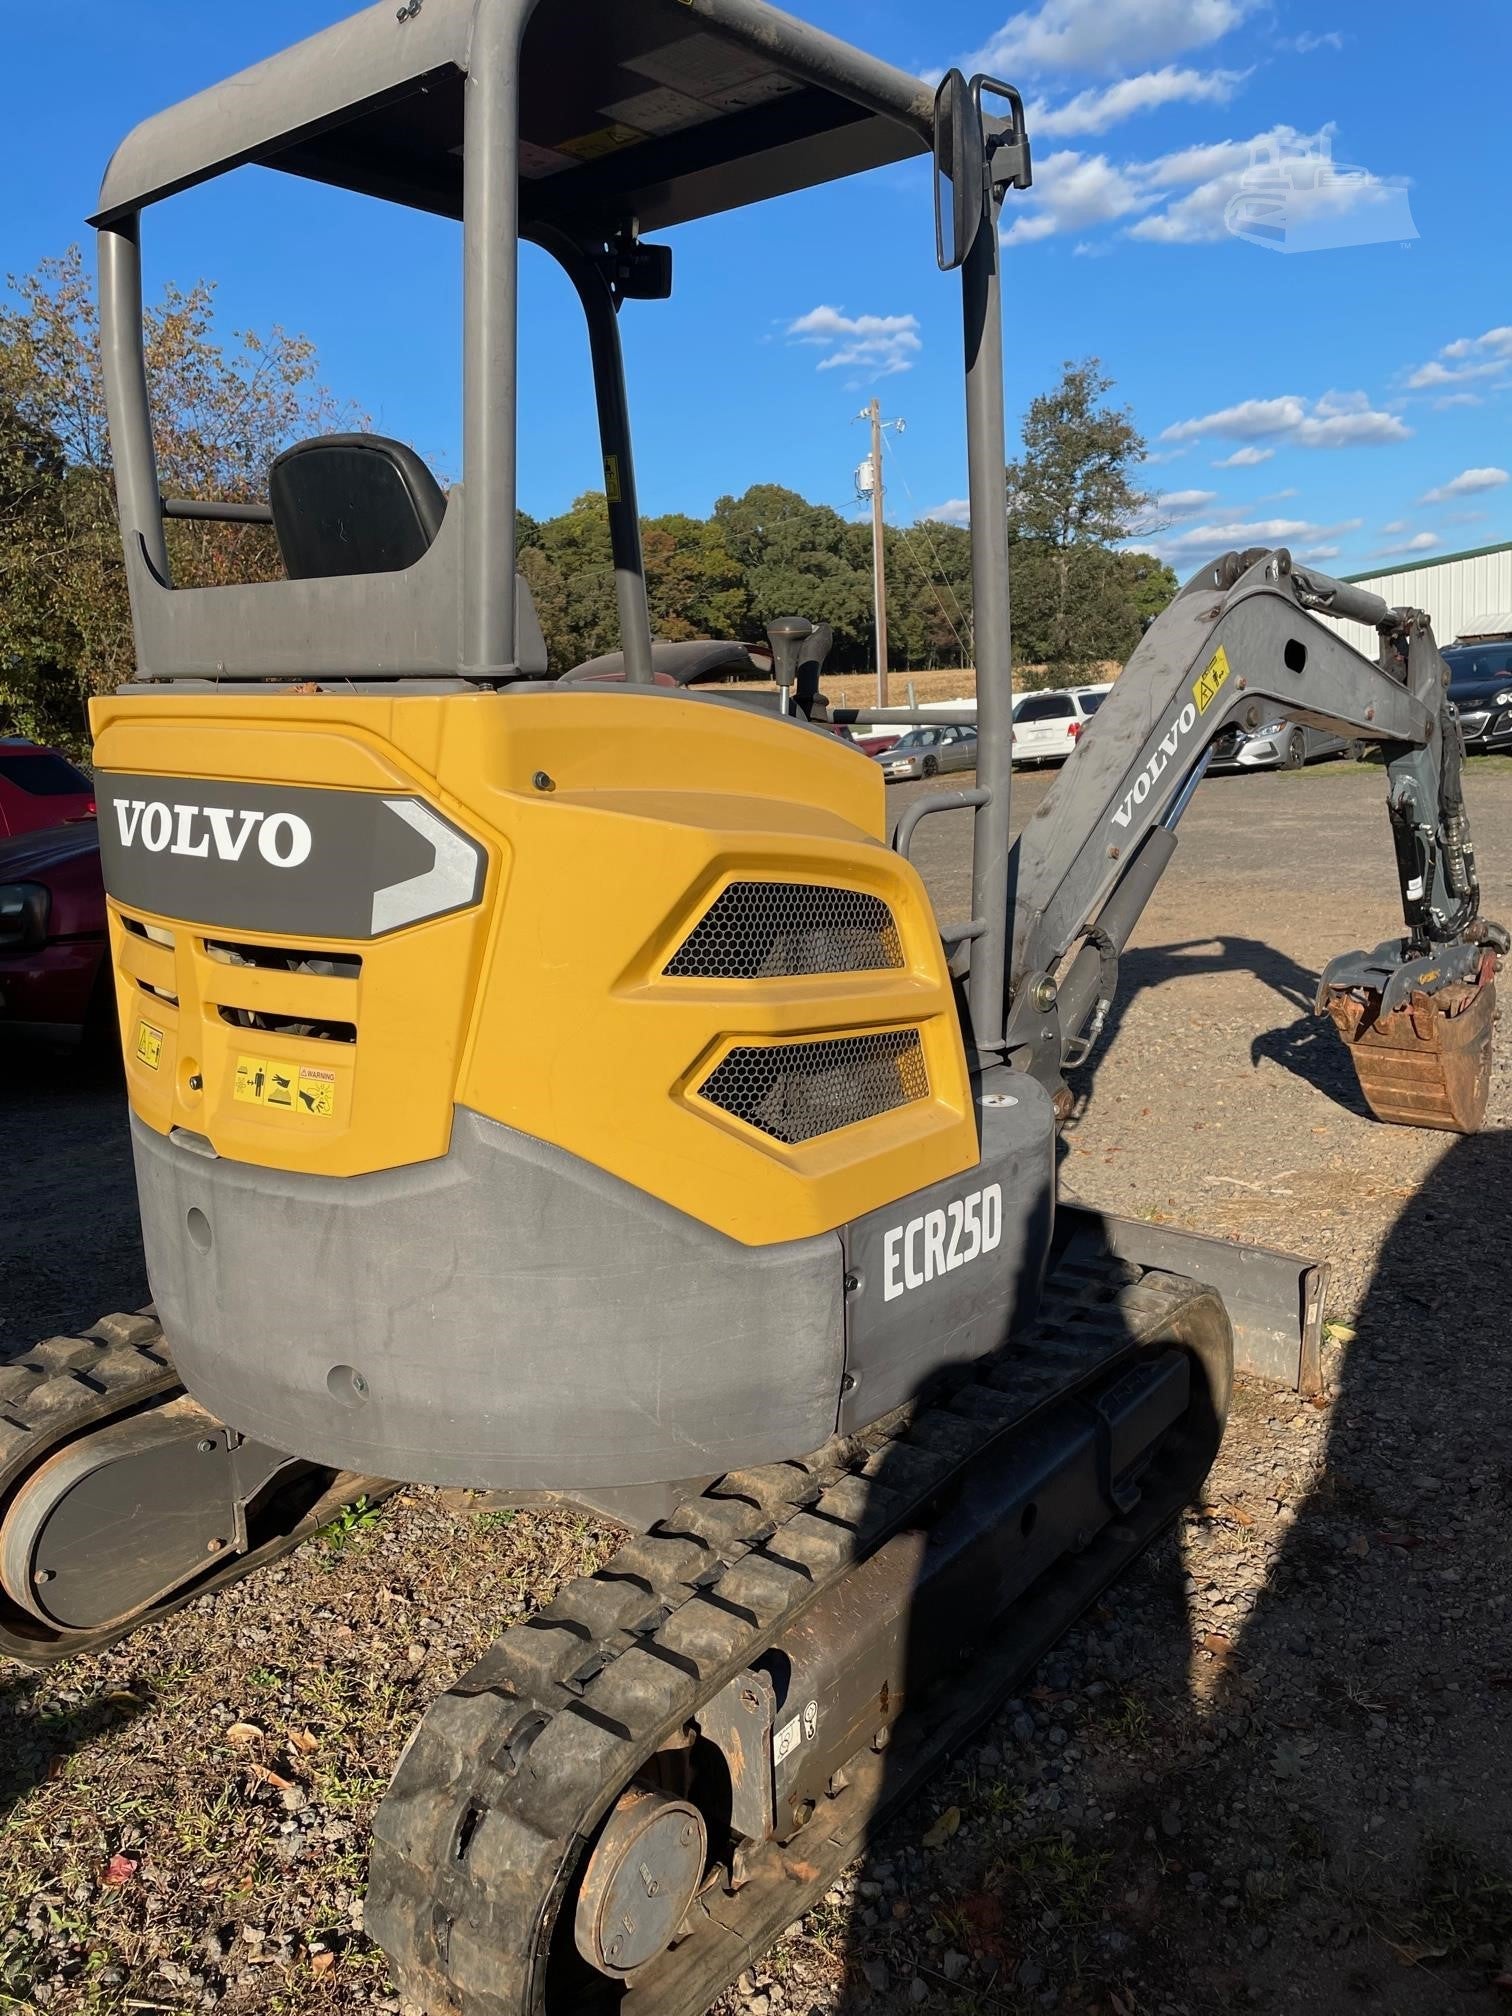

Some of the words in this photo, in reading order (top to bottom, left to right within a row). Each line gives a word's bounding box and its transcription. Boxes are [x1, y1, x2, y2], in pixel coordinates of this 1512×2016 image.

[1110, 702, 1196, 828] VOLVO
[113, 798, 312, 868] VOLVO
[307, 1071, 335, 1081] WARNING
[884, 1183, 1002, 1302] ECR25D
